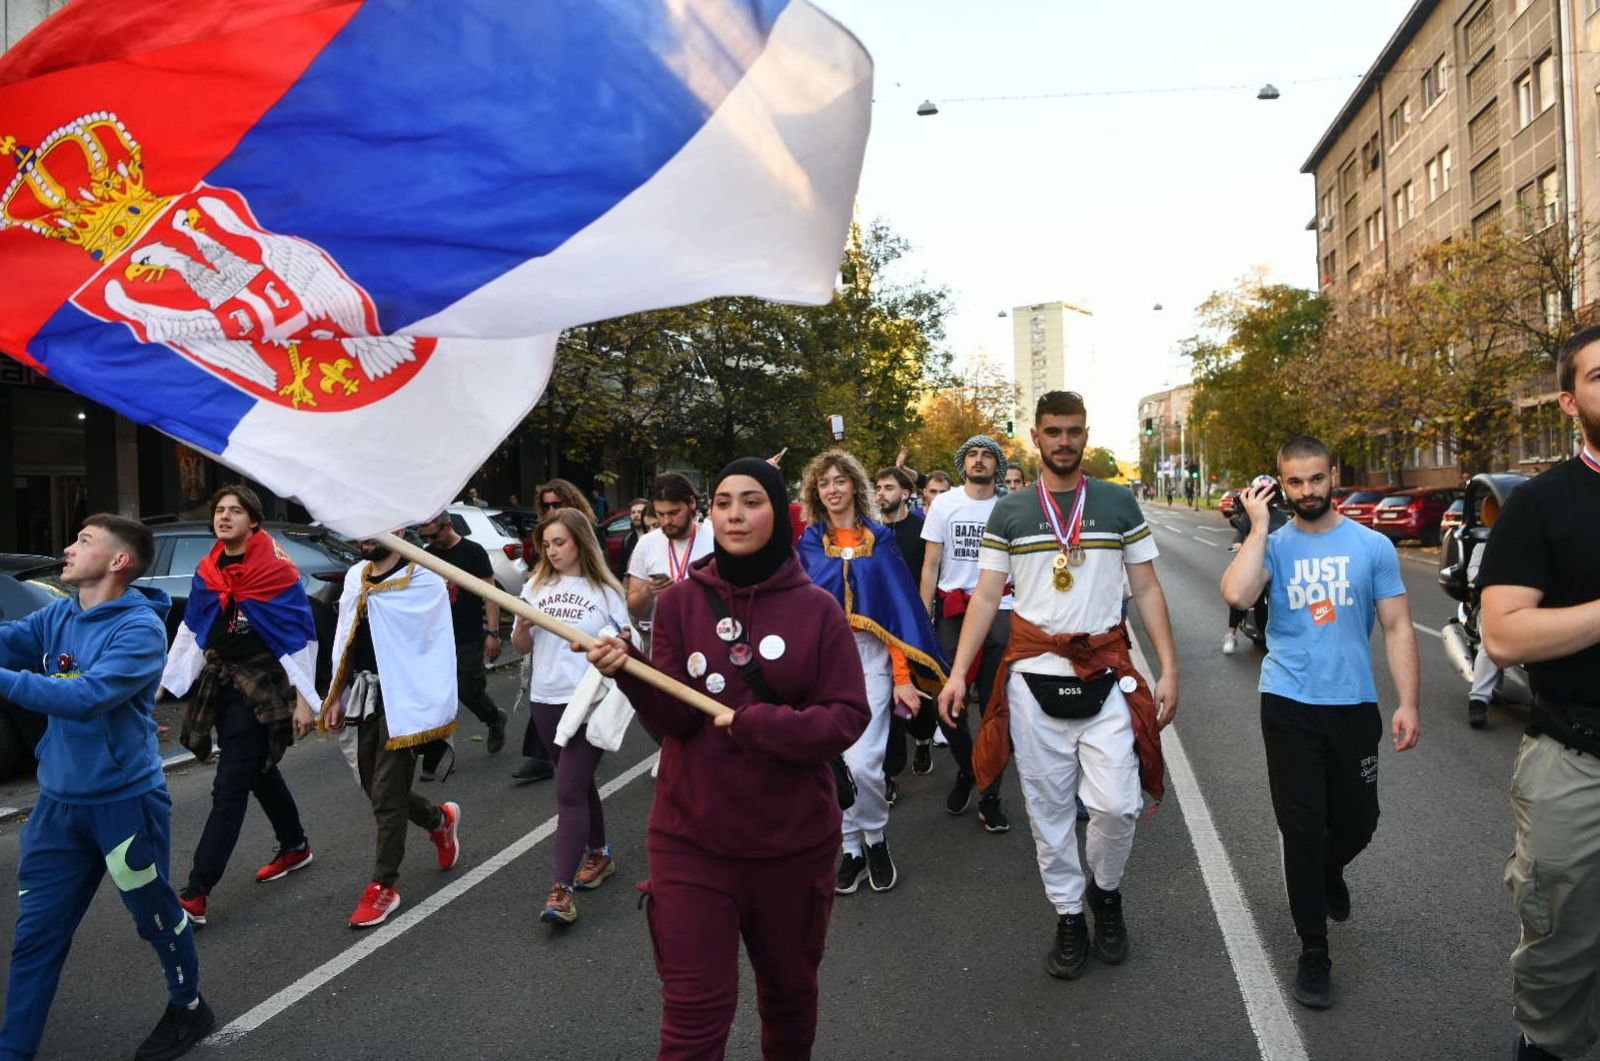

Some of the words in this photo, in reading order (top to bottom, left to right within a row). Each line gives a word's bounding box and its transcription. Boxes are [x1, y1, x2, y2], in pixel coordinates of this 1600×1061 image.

[954, 547, 979, 558] НЕВАЉА
[1289, 556, 1350, 586] JUST
[538, 592, 597, 613] MARSEILLE
[1287, 583, 1326, 610] DO
[1328, 581, 1354, 606] IT.
[544, 607, 585, 619] FRANCE
[1058, 687, 1082, 696] BOSS
